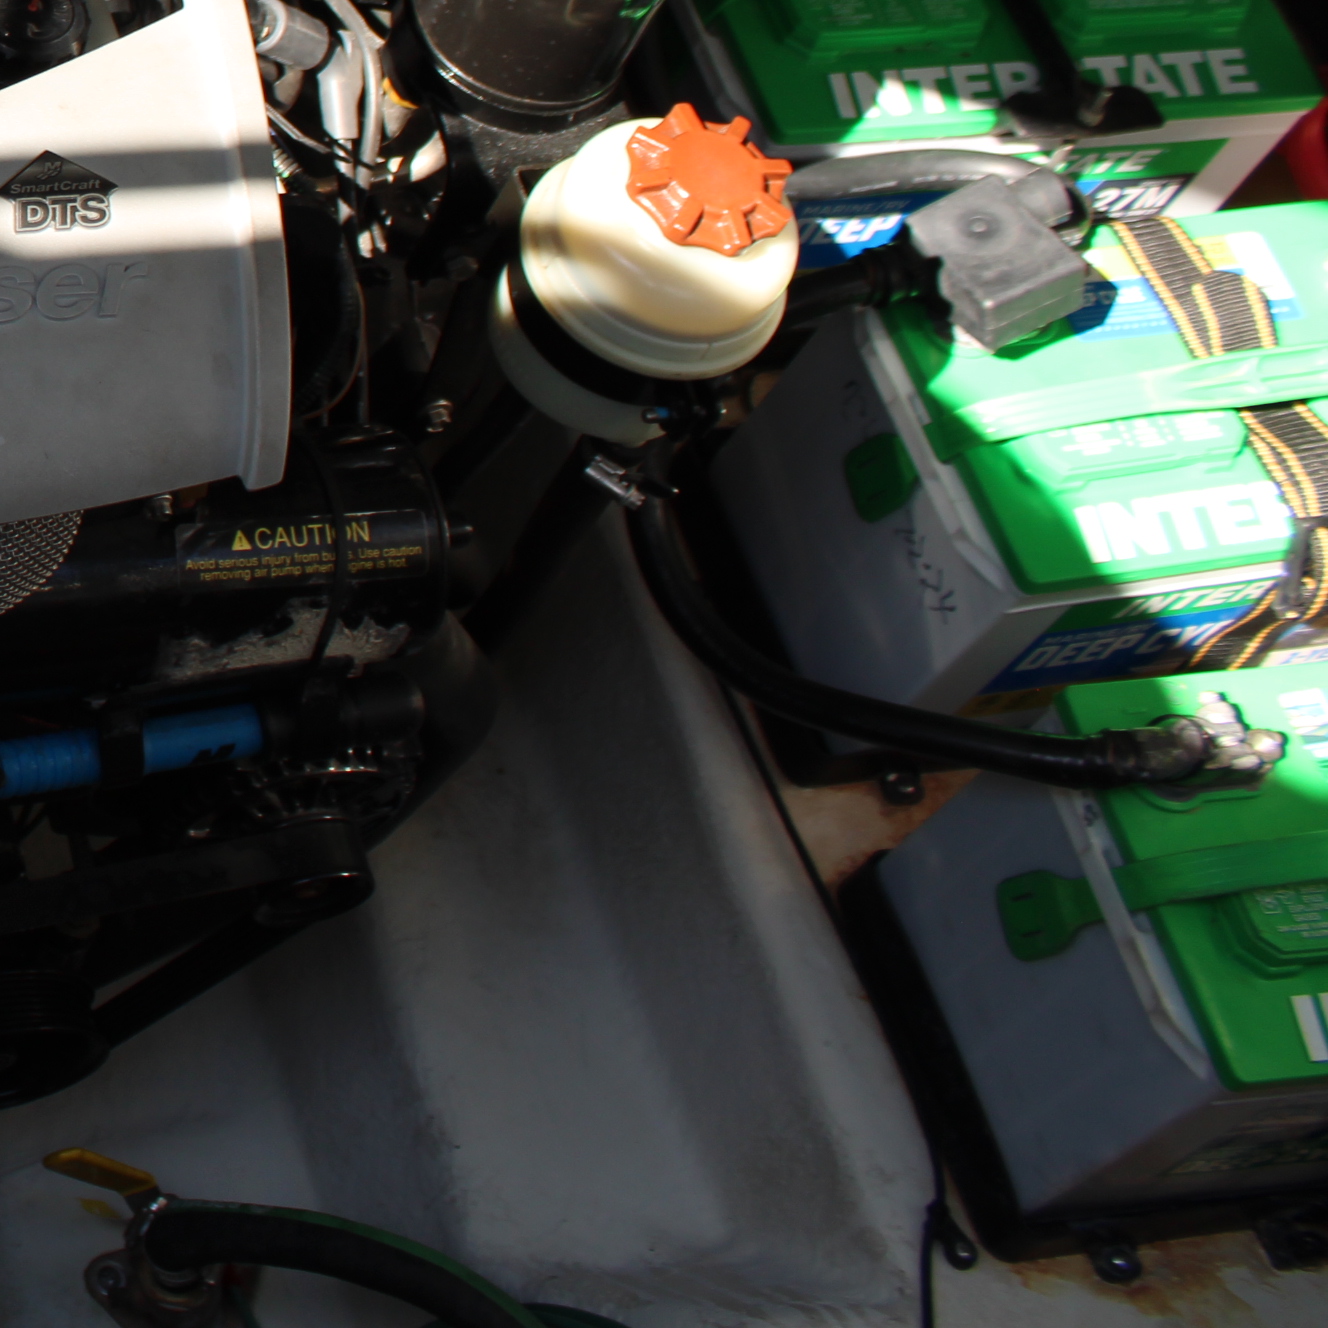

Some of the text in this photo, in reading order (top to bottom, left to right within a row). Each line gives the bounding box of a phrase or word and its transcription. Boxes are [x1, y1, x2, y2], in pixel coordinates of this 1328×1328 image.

[828, 48, 1264, 120] INTERTATE
[10, 179, 101, 194] SmartCraft
[1092, 180, 1182, 211] 27M
[14, 192, 112, 233] DTS
[185, 558, 216, 571] Avoid
[218, 556, 259, 569] serious
[261, 553, 292, 569] injury
[294, 552, 321, 564] from
[358, 547, 381, 560] Use
[382, 545, 423, 558] caution
[199, 567, 252, 583] removing
[253, 565, 268, 577] air
[270, 563, 302, 579] pump
[304, 561, 334, 574] when
[376, 557, 384, 569] is
[1014, 633, 1142, 672] DEEP
